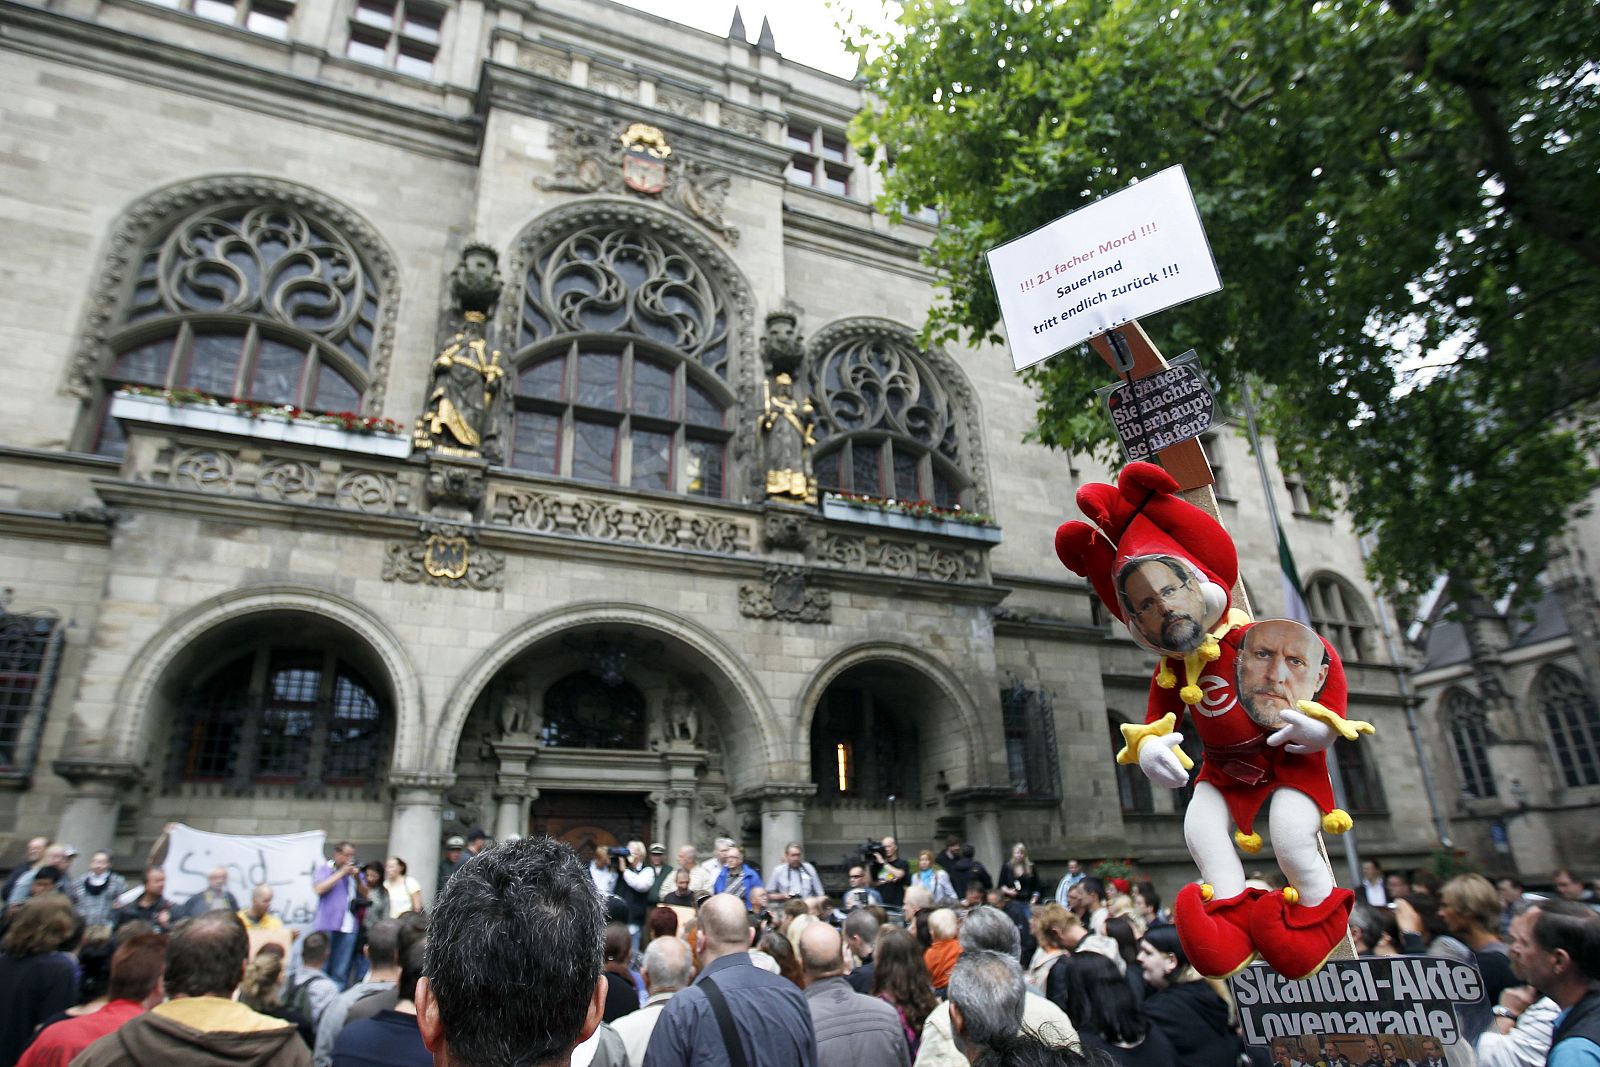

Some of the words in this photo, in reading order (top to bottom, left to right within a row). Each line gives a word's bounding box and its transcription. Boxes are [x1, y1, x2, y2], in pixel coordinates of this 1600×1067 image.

[1037, 269, 1053, 285] 21
[1054, 249, 1097, 275] facher
[1098, 230, 1138, 255] Mord
[1056, 259, 1123, 299] Sauerland
[1033, 315, 1059, 335] tritt
[1061, 291, 1108, 321] endlich
[1111, 271, 1160, 298] zurück
[1113, 405, 1139, 426] Sie
[1140, 378, 1202, 416] nachts
[1120, 392, 1212, 441] überhaupt
[173, 848, 269, 895] Snd
[1233, 959, 1482, 1005] Skandal-Akte
